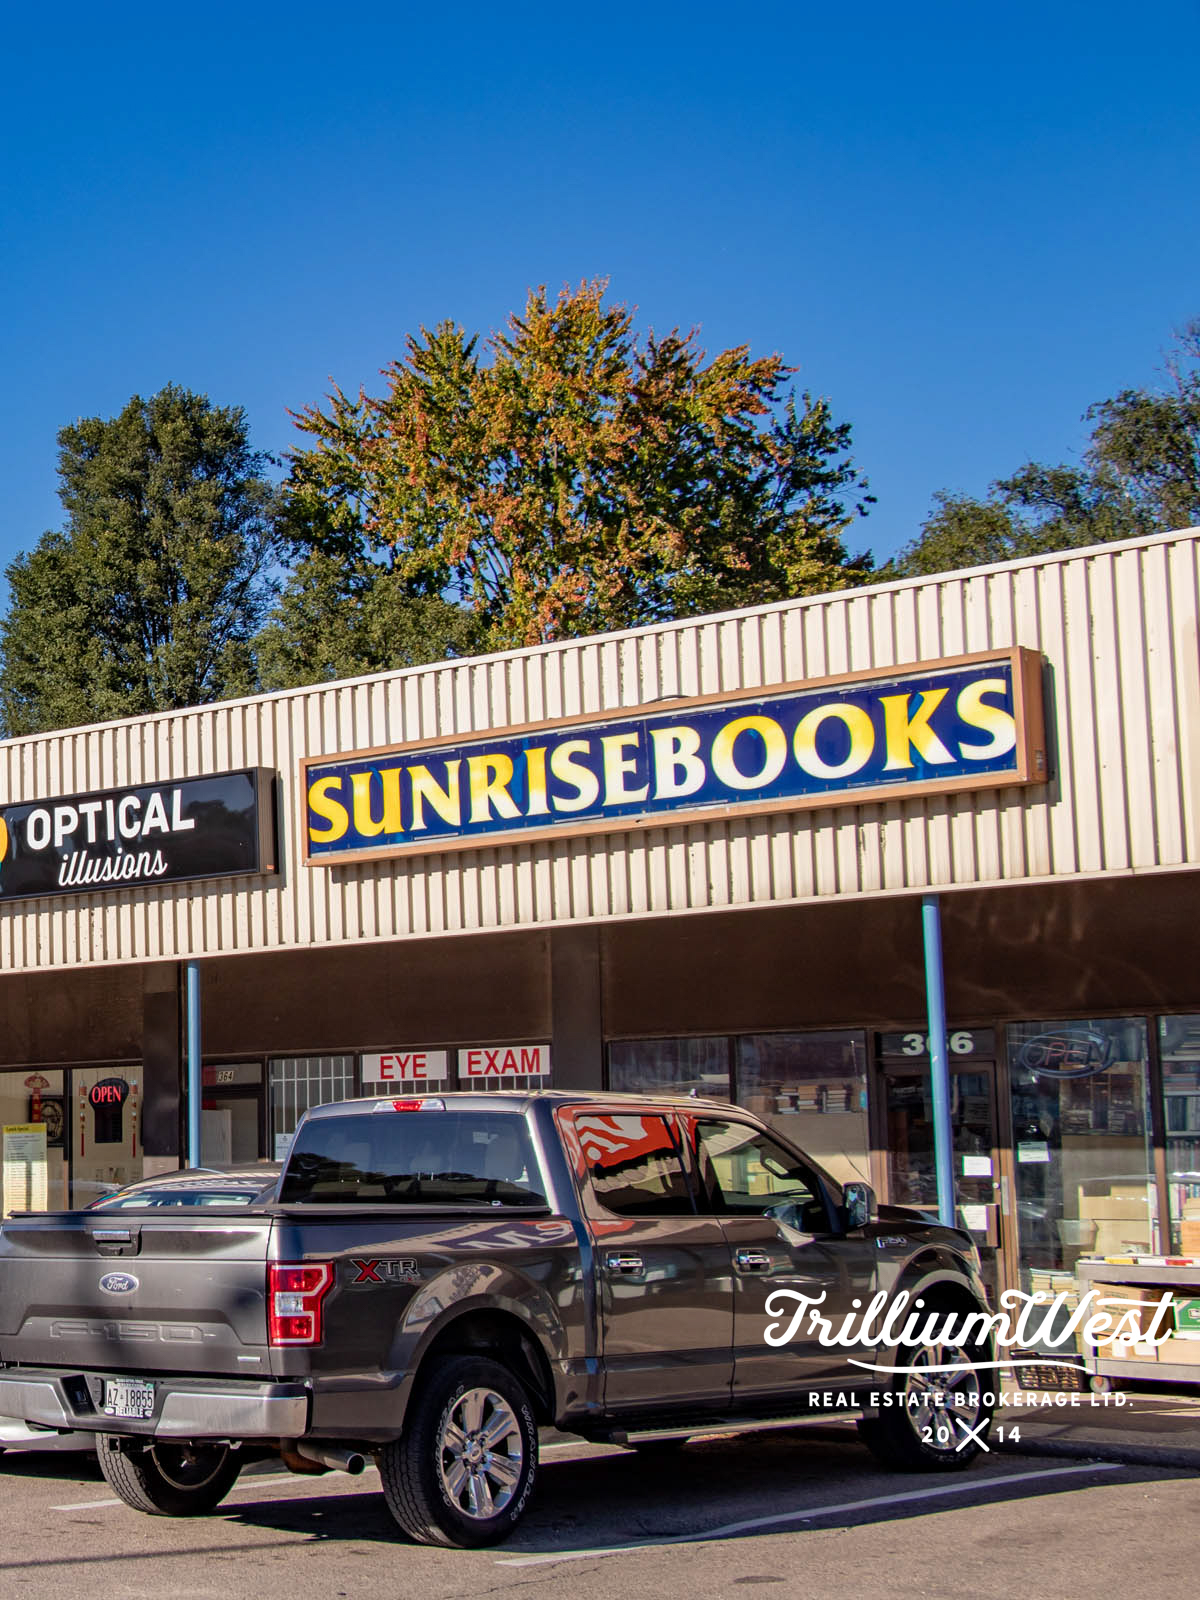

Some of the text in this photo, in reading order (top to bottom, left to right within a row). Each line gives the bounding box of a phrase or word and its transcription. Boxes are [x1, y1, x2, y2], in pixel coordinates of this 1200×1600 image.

[26, 789, 195, 850] OPTICAL
[58, 847, 168, 887] illusions
[902, 1031, 974, 1056] 36
[218, 1071, 233, 1082] 364
[380, 1048, 541, 1080] EYE EXAM
[91, 1086, 122, 1103] OPEN
[350, 1258, 420, 1283] XTR
[106, 1276, 130, 1291] Ford
